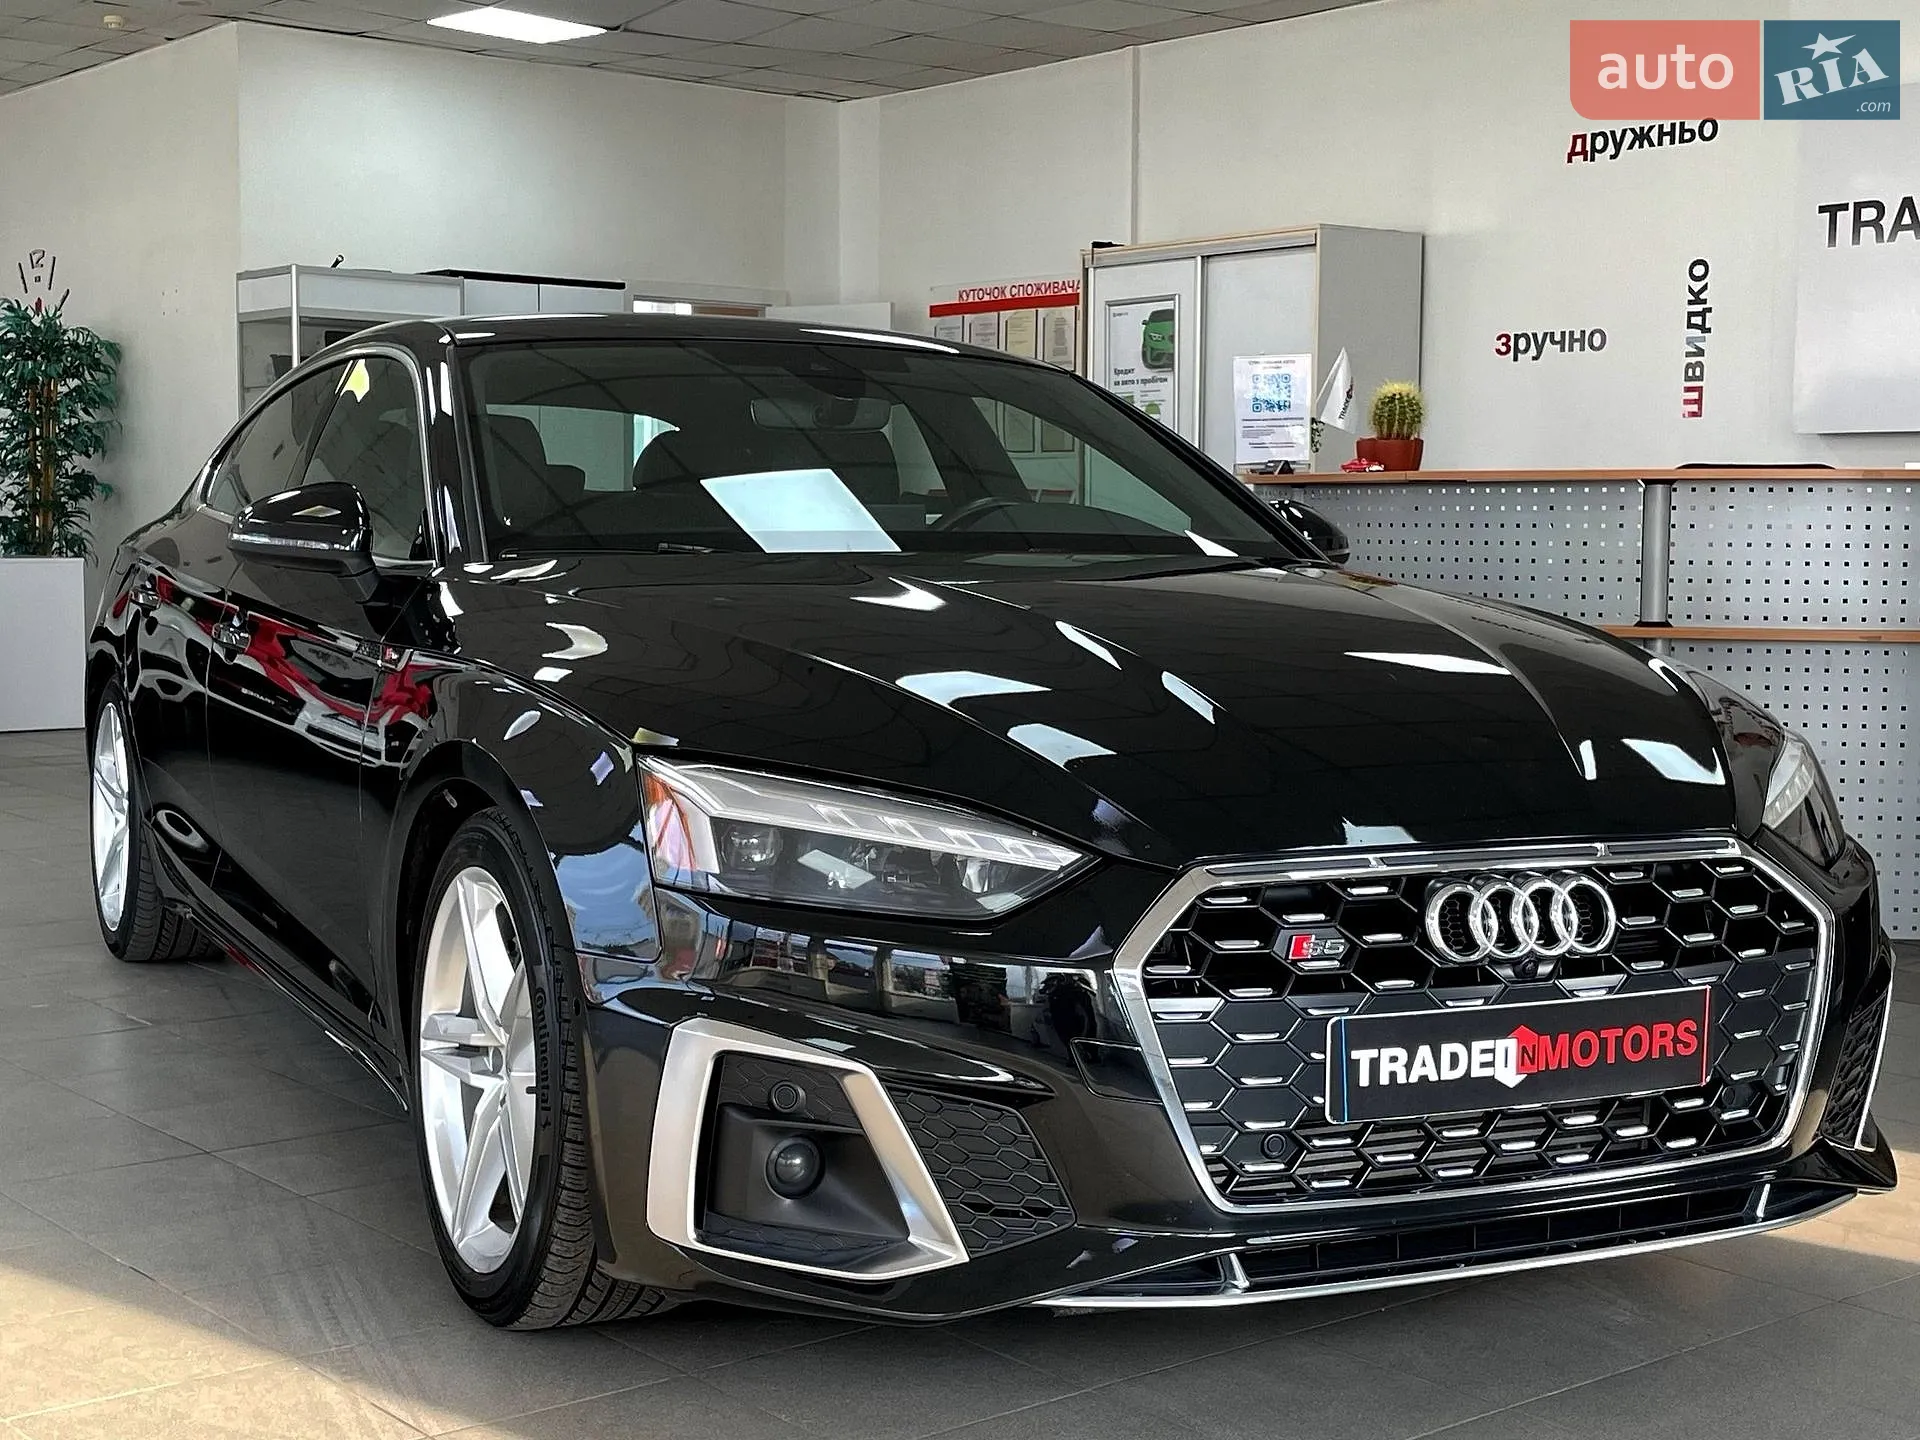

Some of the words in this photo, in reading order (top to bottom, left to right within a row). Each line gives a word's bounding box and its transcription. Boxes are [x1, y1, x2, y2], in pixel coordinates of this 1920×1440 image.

[1566, 117, 1719, 164] дружньо
[1818, 196, 1920, 248] TRA
[958, 286, 1007, 301] КУТОЧОК
[1495, 328, 1607, 362] зручно
